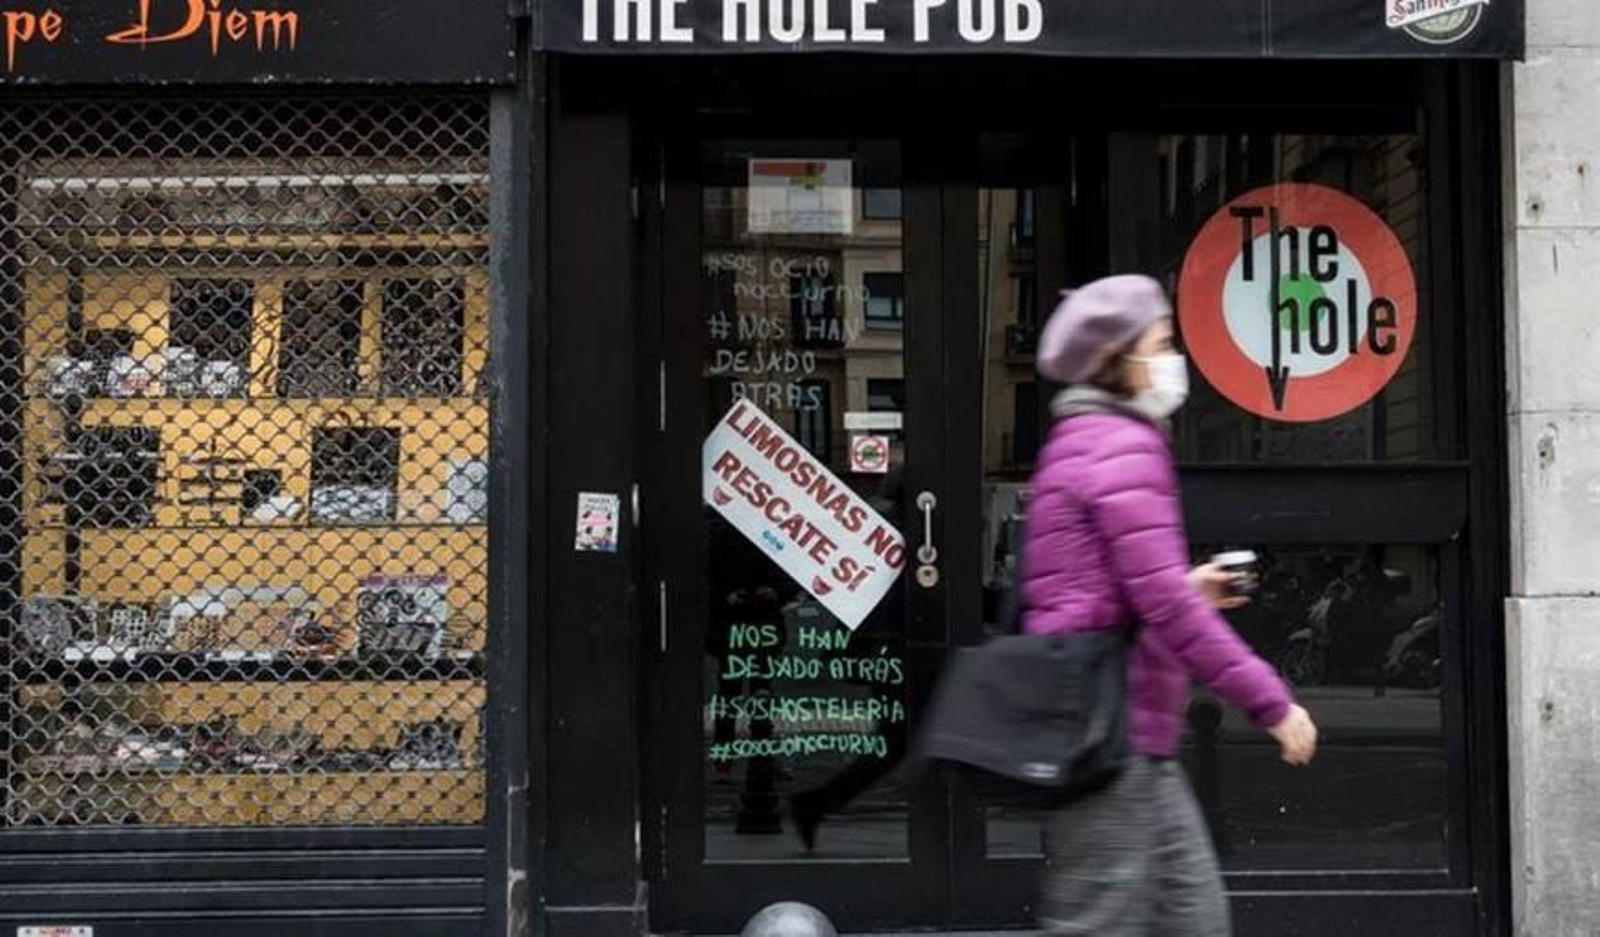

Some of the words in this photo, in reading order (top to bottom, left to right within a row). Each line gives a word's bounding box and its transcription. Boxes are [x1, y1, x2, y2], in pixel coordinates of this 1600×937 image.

[105, 0, 298, 56] Diem
[1229, 206, 1340, 282] The
[1270, 279, 1397, 355] hole
[711, 450, 838, 565] RESCATE
[831, 556, 876, 592] SÍ
[726, 404, 868, 533] LIMOSNAS
[864, 525, 907, 569] NO
[722, 653, 822, 679] DEJADO
[829, 646, 904, 684] ATRÁS
[729, 623, 779, 649] NOS
[799, 627, 850, 650] HAN
